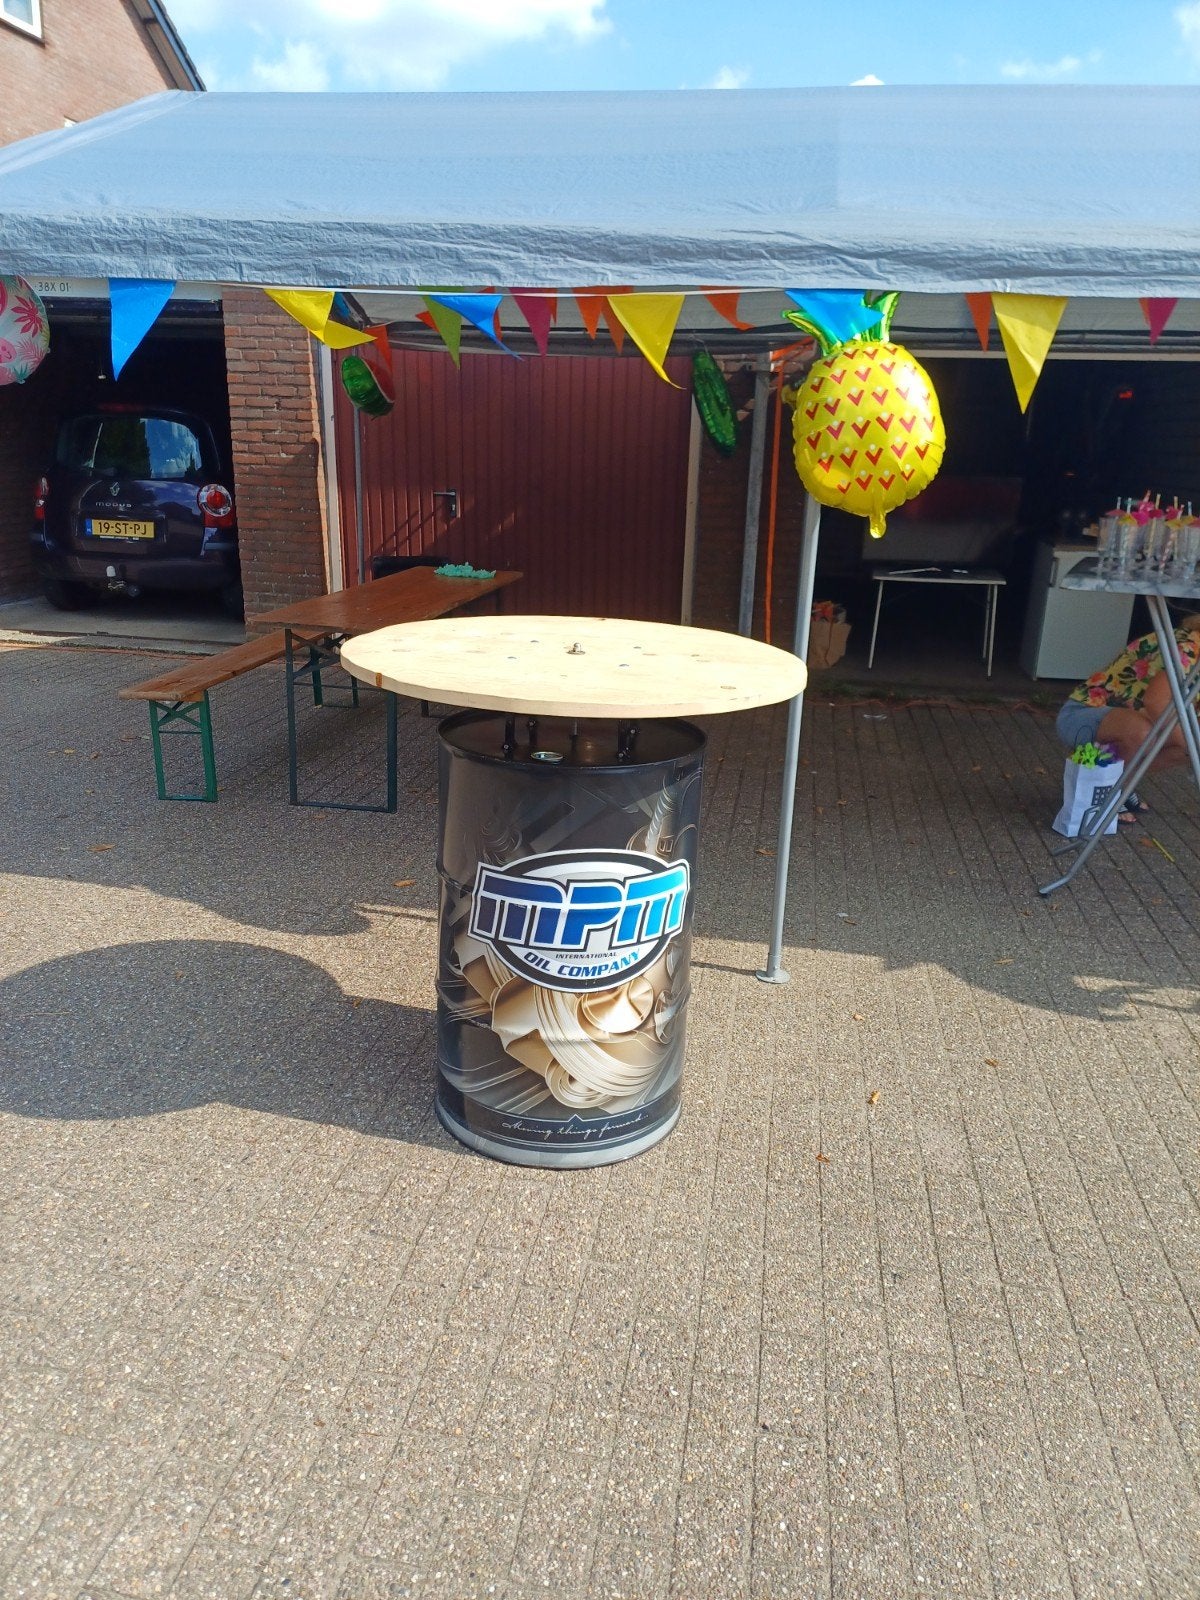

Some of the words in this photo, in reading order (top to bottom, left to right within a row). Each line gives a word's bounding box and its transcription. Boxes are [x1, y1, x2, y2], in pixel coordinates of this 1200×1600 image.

[98, 522, 147, 535] 19-ST-PJ
[523, 951, 551, 972] OIL
[557, 948, 640, 977] COMPANY
[555, 951, 617, 960] INTERNATIONAL
[501, 1120, 553, 1140] Moving
[557, 1124, 597, 1140] things
